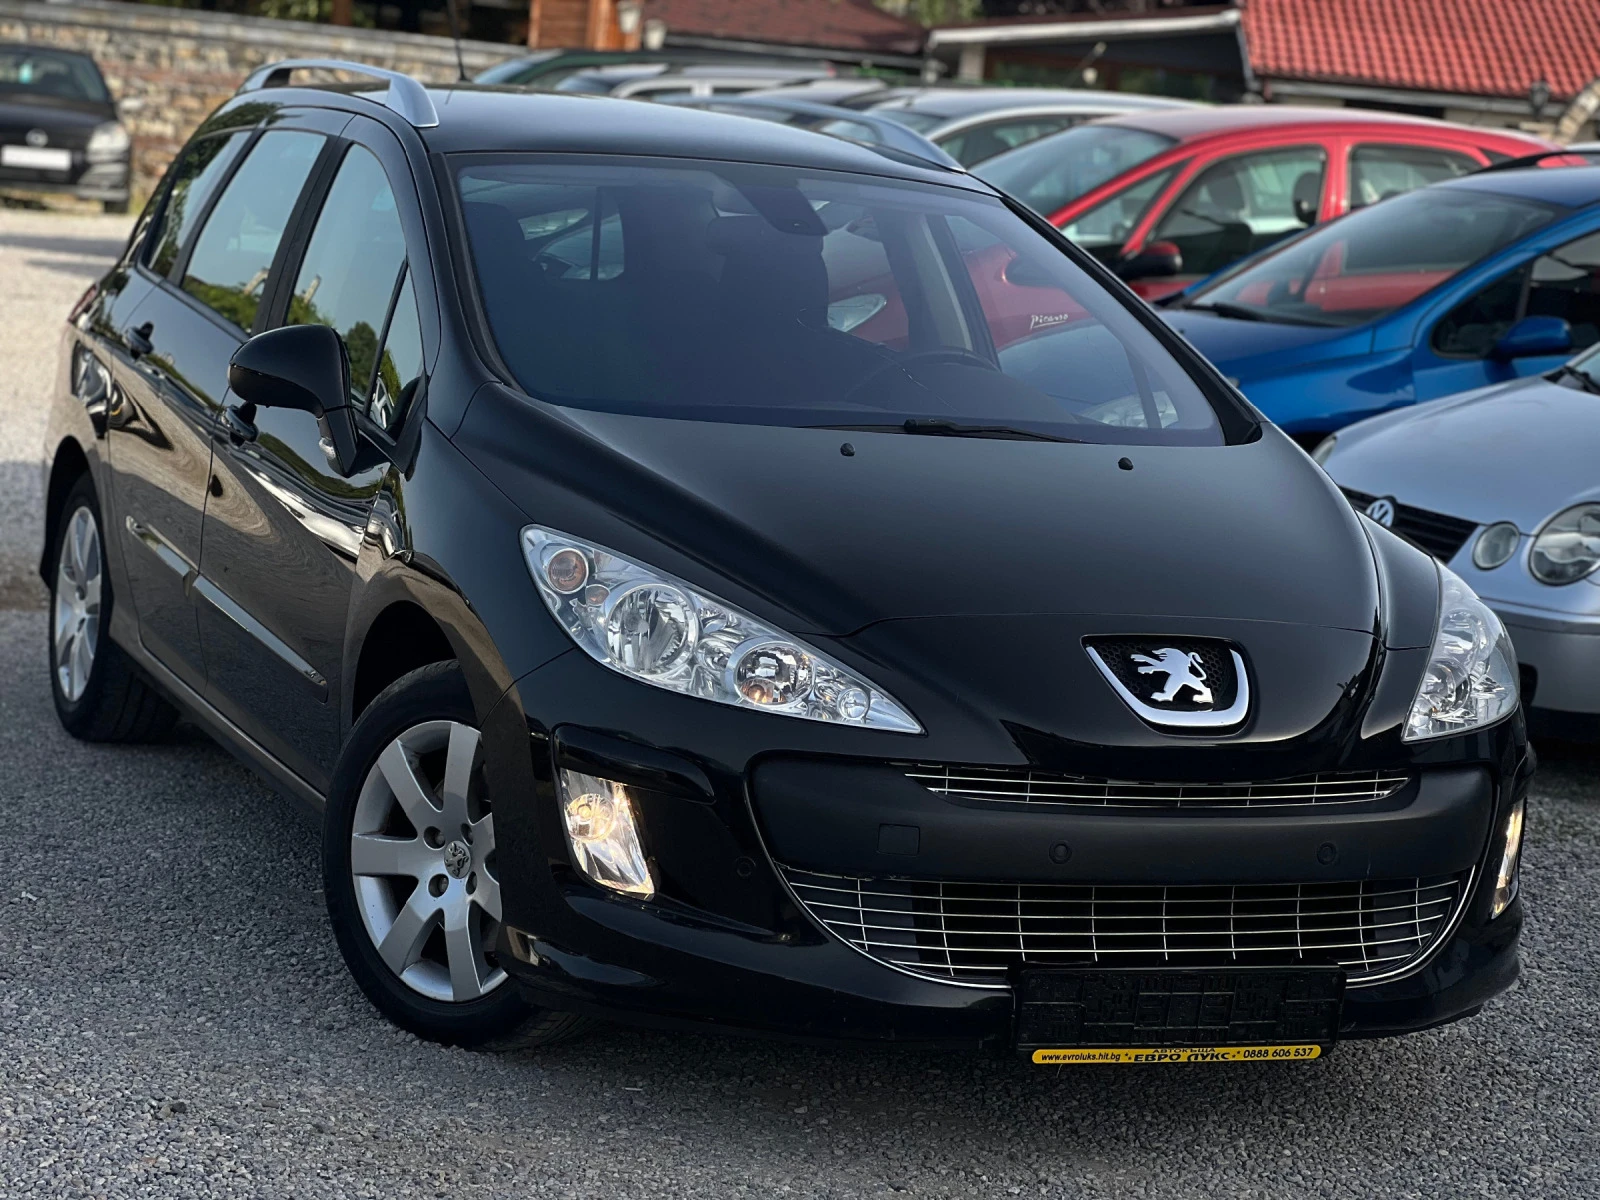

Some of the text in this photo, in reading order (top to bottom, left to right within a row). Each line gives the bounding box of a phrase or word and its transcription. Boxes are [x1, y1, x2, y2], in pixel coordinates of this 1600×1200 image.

[1041, 1052, 1121, 1062] www.evroluks.hit.bg
[1134, 1052, 1230, 1062] ЕВРО ЛУКС
[1243, 1047, 1314, 1059] 0888 606 537
